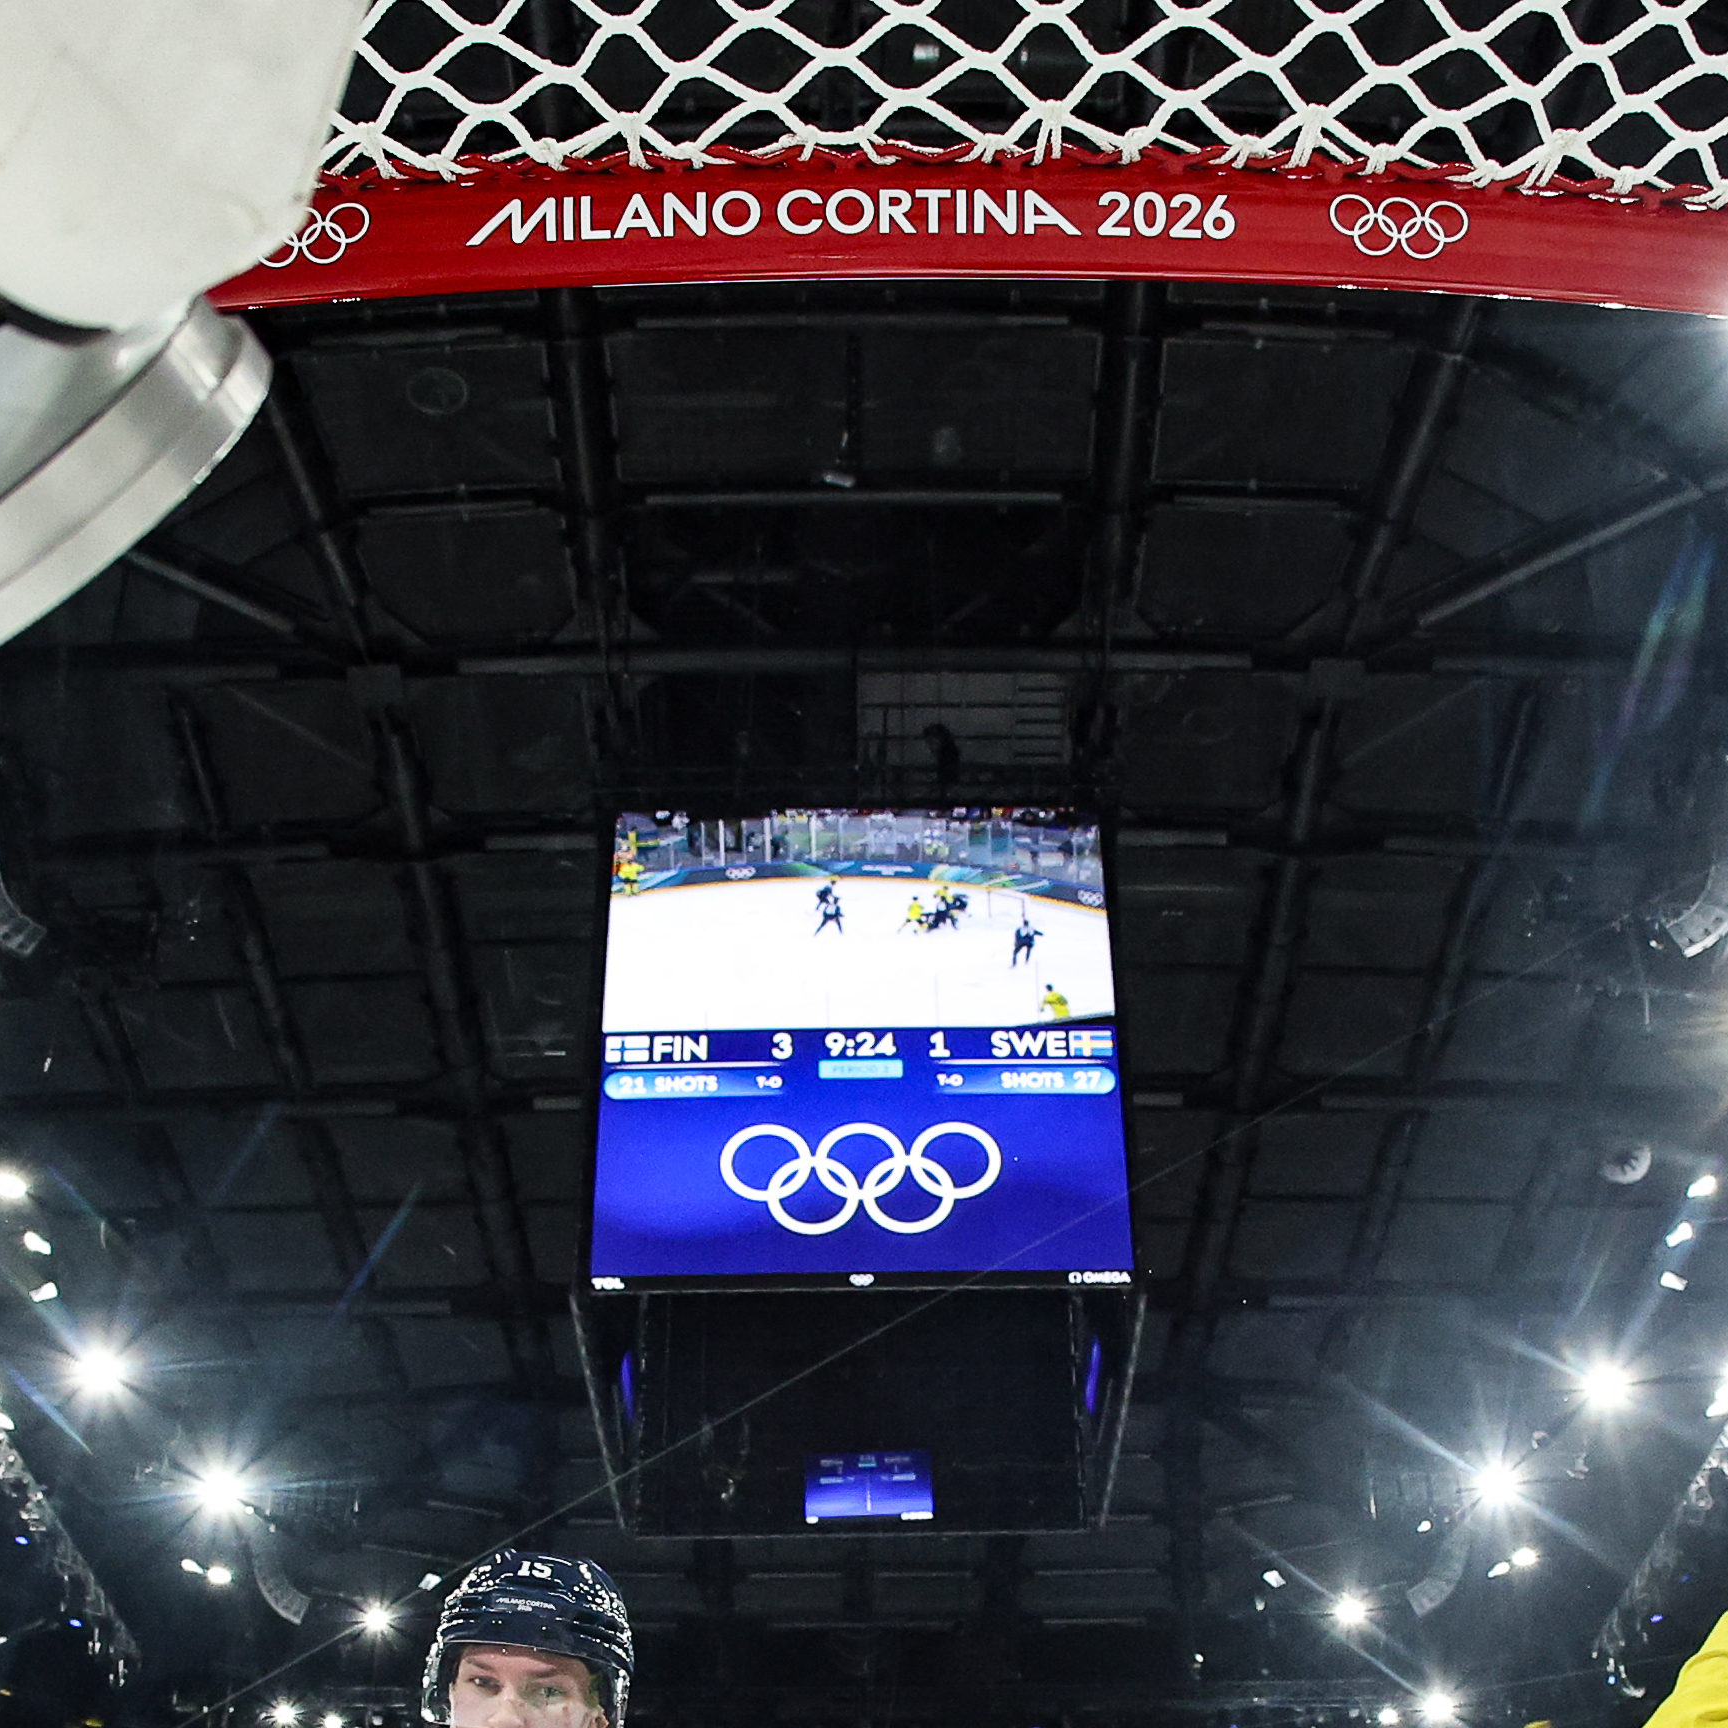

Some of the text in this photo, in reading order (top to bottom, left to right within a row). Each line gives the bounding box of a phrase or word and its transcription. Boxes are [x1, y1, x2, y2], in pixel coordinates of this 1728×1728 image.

[465, 188, 1236, 246] MILANO CORTINA 2026
[652, 1030, 1068, 1062] FIN 3 9:24 1 SWE
[618, 1074, 647, 1095] 21
[654, 1073, 719, 1093] SHOTS
[1000, 1071, 1065, 1089] SHOTS
[1073, 1070, 1102, 1089] 27
[591, 1276, 626, 1290] TCL
[1082, 1270, 1132, 1284] OMEGA
[517, 1560, 554, 1580] 15
